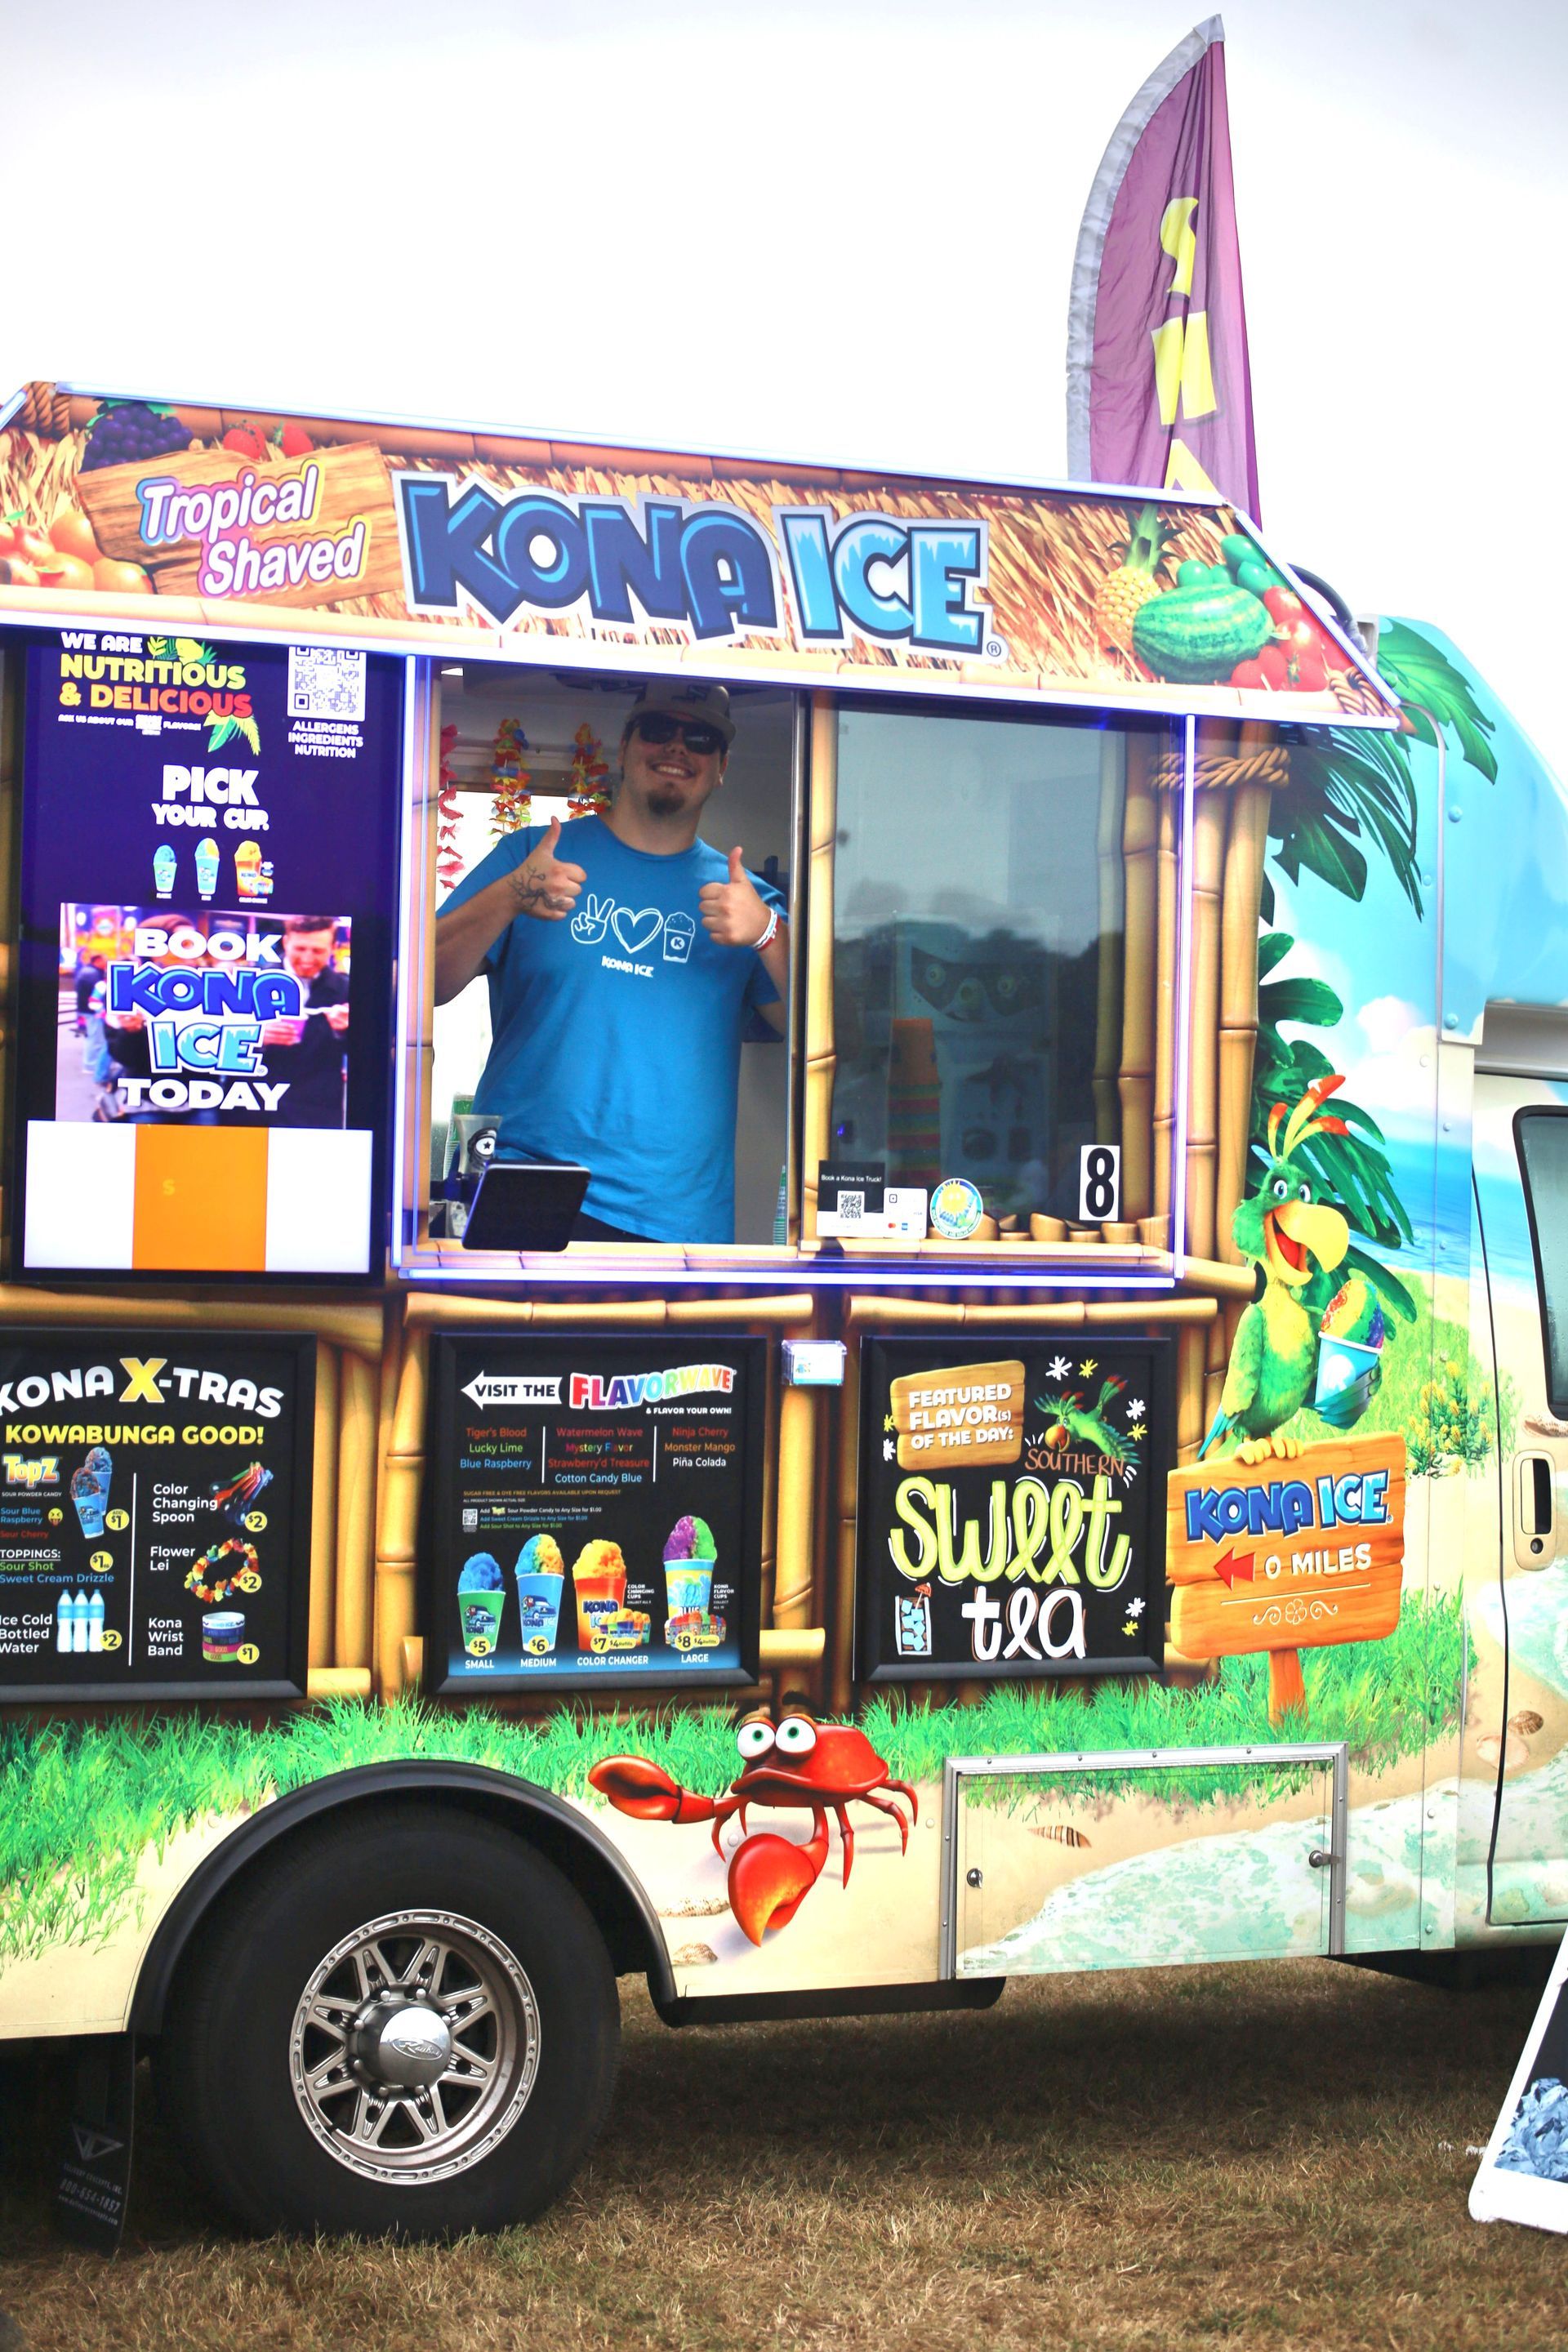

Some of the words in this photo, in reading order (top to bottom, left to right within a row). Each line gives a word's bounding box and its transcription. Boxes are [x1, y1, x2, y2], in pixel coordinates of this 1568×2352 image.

[141, 463, 321, 544] Tropical
[203, 523, 365, 596] Shaved
[399, 477, 778, 641] KONA
[780, 512, 983, 655] ICE
[60, 631, 97, 653] WE
[101, 634, 143, 654] ARE
[60, 653, 247, 690] NUTRITIOUS
[59, 682, 82, 707] &
[90, 684, 253, 719] DELICIOUS
[292, 720, 359, 735] ALLERGENS
[287, 732, 364, 747] INGREDIENTS
[294, 743, 357, 759] NUTRITION
[162, 764, 261, 807] PICK
[150, 803, 218, 828] YOUR
[223, 806, 270, 832] CUP.
[134, 927, 283, 964] BOOK
[601, 955, 634, 973] KONA
[634, 964, 655, 978] ICE
[109, 964, 301, 1022] KONA
[151, 1021, 262, 1072] ICE
[117, 1077, 292, 1111] TODAY
[821, 1174, 835, 1182] Book
[840, 1174, 855, 1183] Kona
[1085, 1147, 1116, 1218] 8
[118, 1356, 284, 1419] X-TRAS
[474, 1383, 519, 1398] VISIT
[523, 1383, 556, 1397] THE
[570, 1365, 733, 1409] FLAVORWAVE
[909, 1383, 1012, 1409] FEATURED
[5, 1424, 176, 1445] KOWABUNGA
[181, 1425, 265, 1446] GOOD!
[466, 1427, 497, 1440] Tiger's
[499, 1427, 527, 1437] Blood
[556, 1428, 614, 1437] Watermelon
[617, 1428, 644, 1437] Wave
[672, 1427, 695, 1438] Ninja
[698, 1427, 729, 1438] Cherry
[911, 1434, 934, 1450] OF
[938, 1430, 972, 1447] THE
[976, 1426, 1014, 1443] DAY:
[469, 1443, 497, 1455] Lucky
[500, 1442, 523, 1452] Lime
[565, 1443, 603, 1454] Mystery
[664, 1442, 702, 1452] Monster
[704, 1442, 736, 1454] Mango
[460, 1458, 481, 1468] Blue
[484, 1458, 532, 1470] Raspberry
[610, 1458, 650, 1468] Treasure
[673, 1457, 692, 1467] Piña
[695, 1457, 726, 1467] Colada
[1024, 1448, 1125, 1477] SOUTHERN
[2, 1454, 59, 1489] TopZ
[555, 1474, 586, 1483] Cotton
[589, 1473, 619, 1485] Candy
[621, 1473, 642, 1483] Blue
[153, 1483, 189, 1495] Color
[152, 1497, 218, 1511] Changing
[1185, 1480, 1315, 1544] KONA
[1316, 1468, 1390, 1529] ICE
[0, 1516, 43, 1525] Raspberry
[111, 1515, 122, 1528] $1
[152, 1511, 195, 1525] Spoon
[248, 1515, 263, 1528] $2
[20, 1530, 49, 1539] Cherry
[0, 1549, 61, 1559] TOPPINGS:
[150, 1546, 196, 1557] Flower
[0, 1562, 25, 1571] Sour
[28, 1561, 55, 1571] Shot
[150, 1559, 170, 1571] Lei
[1264, 1555, 1281, 1580] 0
[1290, 1543, 1372, 1576] MILES
[0, 1574, 34, 1584] Sweet
[37, 1574, 74, 1583] Cream
[77, 1572, 115, 1583] Drizzle
[243, 1576, 258, 1589] $2
[583, 1600, 618, 1614] KONA
[22, 1613, 53, 1626] Cold
[148, 1617, 183, 1629] Kona
[960, 1585, 1086, 1661] tea
[0, 1627, 50, 1639] Bottled
[148, 1630, 184, 1642] Wrist
[102, 1633, 118, 1647] $2
[473, 1640, 486, 1653] $5
[532, 1639, 546, 1652] $6
[593, 1638, 607, 1650] $7
[677, 1635, 691, 1648] $8
[0, 1643, 39, 1653] Water
[147, 1644, 183, 1656] Band
[242, 1647, 253, 1661] $1
[465, 1659, 495, 1669] SMALL
[520, 1658, 557, 1667] MEDIUM
[577, 1657, 606, 1666] COLOR
[608, 1655, 649, 1665] CHANGER
[681, 1653, 709, 1663] LARGE
